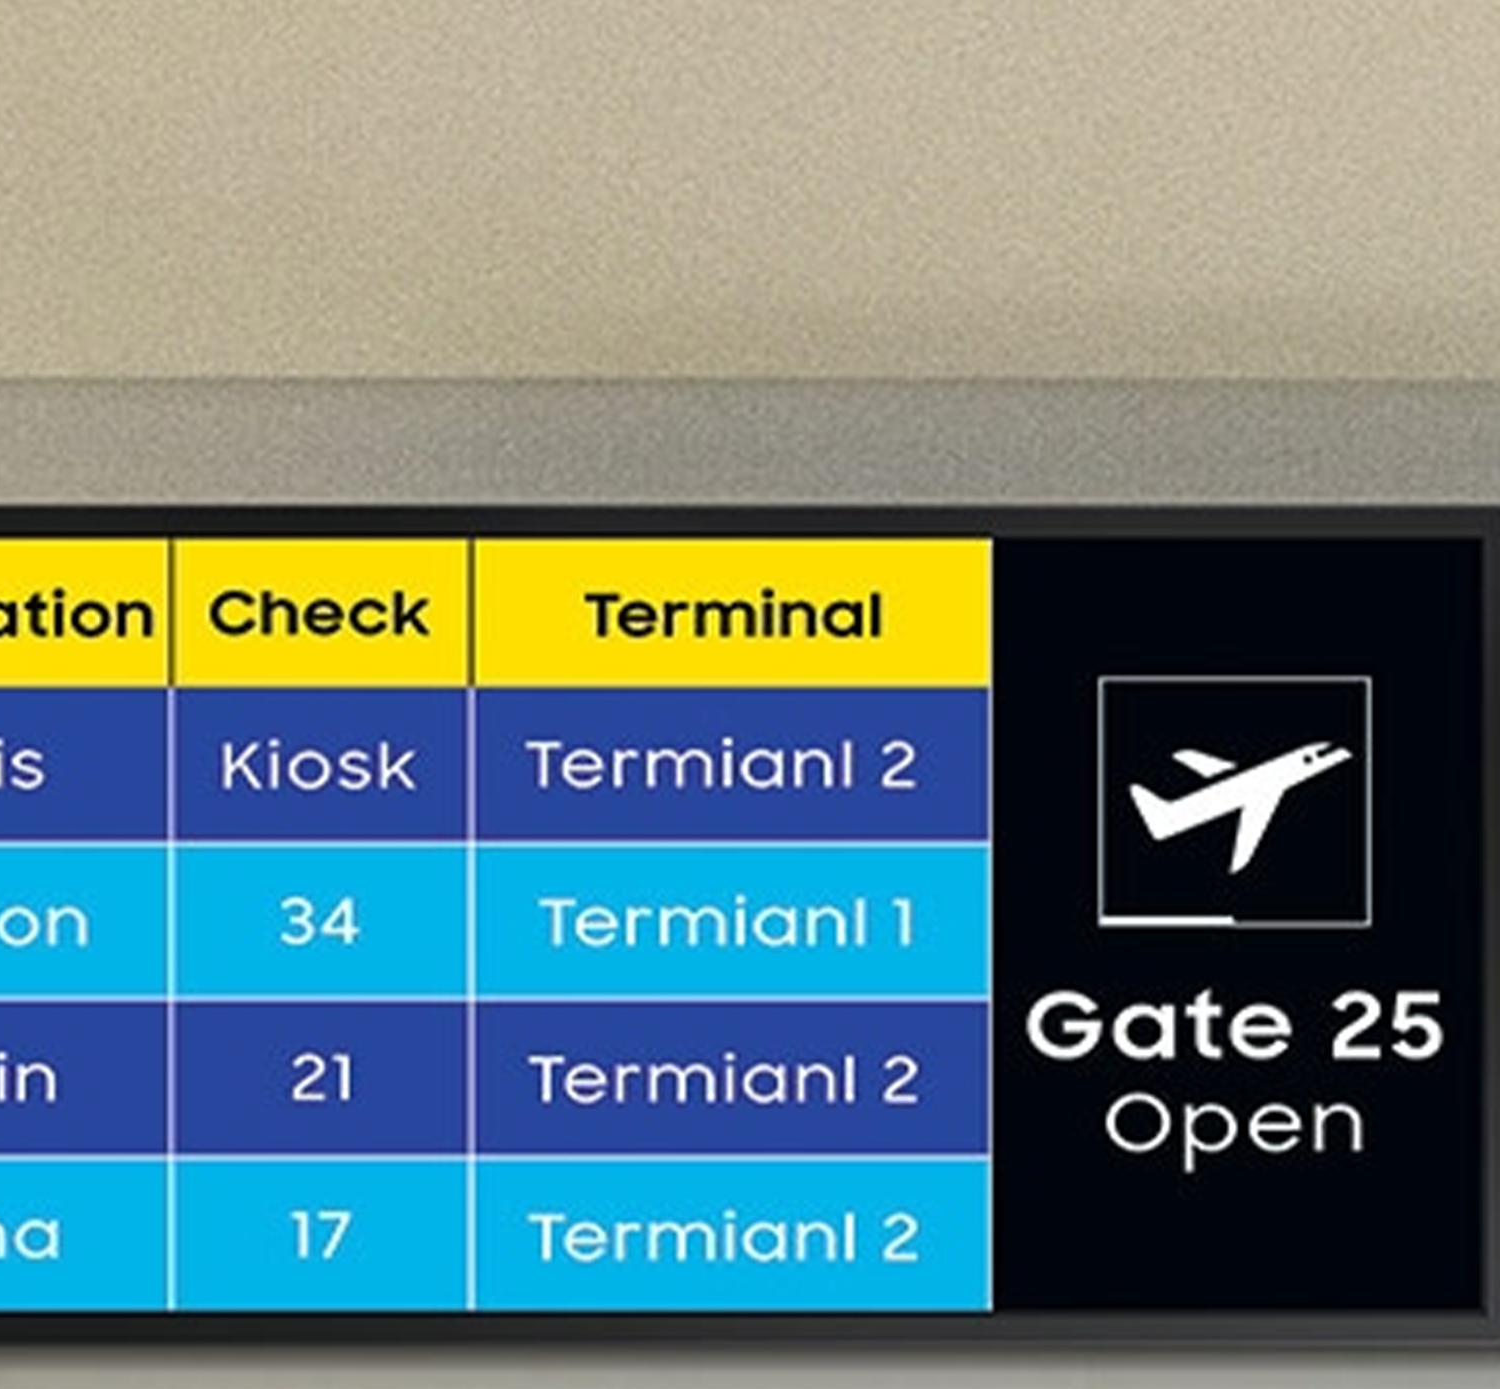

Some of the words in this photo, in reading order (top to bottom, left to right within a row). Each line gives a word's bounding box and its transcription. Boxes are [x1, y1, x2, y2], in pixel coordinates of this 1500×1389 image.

[210, 590, 429, 636] Check
[584, 588, 881, 638] Terminal
[224, 739, 414, 789] Kiosk
[526, 738, 851, 788] Termianl
[882, 741, 915, 788] 2
[282, 897, 359, 944] 34
[540, 895, 865, 946] Termianl
[893, 899, 911, 945] 1
[1027, 990, 1292, 1059] Gate
[1333, 991, 1442, 1059] 25
[293, 1054, 349, 1100] 21
[529, 1053, 854, 1103] Termianl
[884, 1056, 917, 1103] 2
[1106, 1093, 1361, 1172] Open
[292, 1211, 351, 1258] 17
[529, 1210, 854, 1262] Termianl
[884, 1213, 917, 1261] 2
